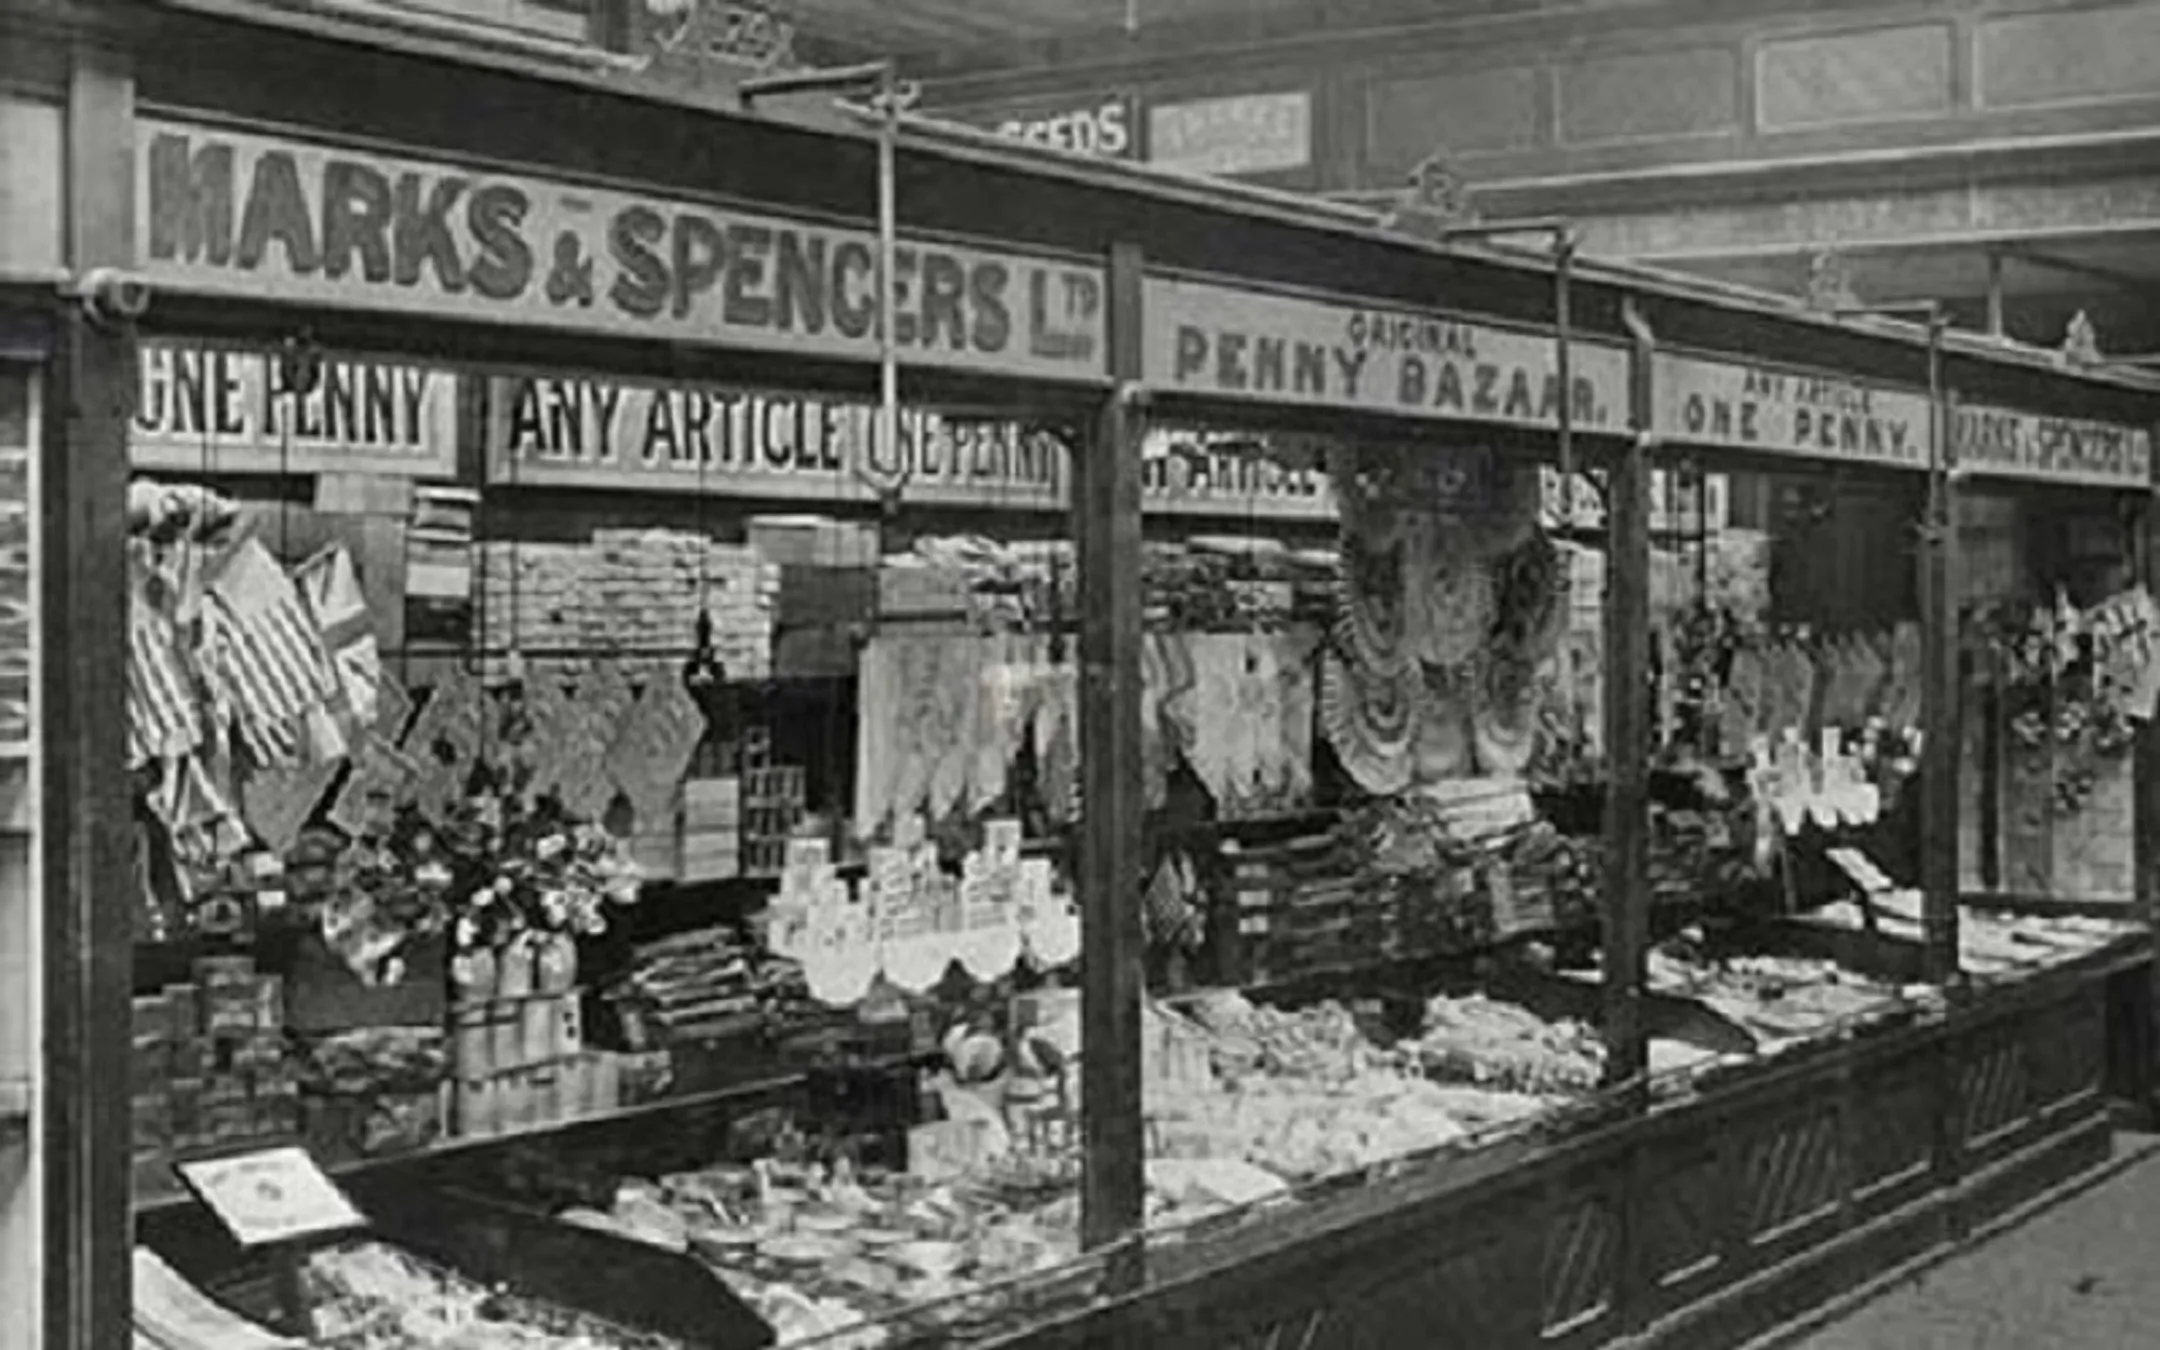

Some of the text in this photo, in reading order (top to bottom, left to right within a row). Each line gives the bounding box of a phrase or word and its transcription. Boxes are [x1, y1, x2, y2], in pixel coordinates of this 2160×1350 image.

[149, 132, 534, 300] MARKS
[547, 230, 593, 307] &
[608, 206, 1010, 353] SPENCERS
[1175, 325, 1368, 398] PENNY
[510, 376, 842, 472] ANY ARTICLE
[1687, 392, 1759, 441] ONE
